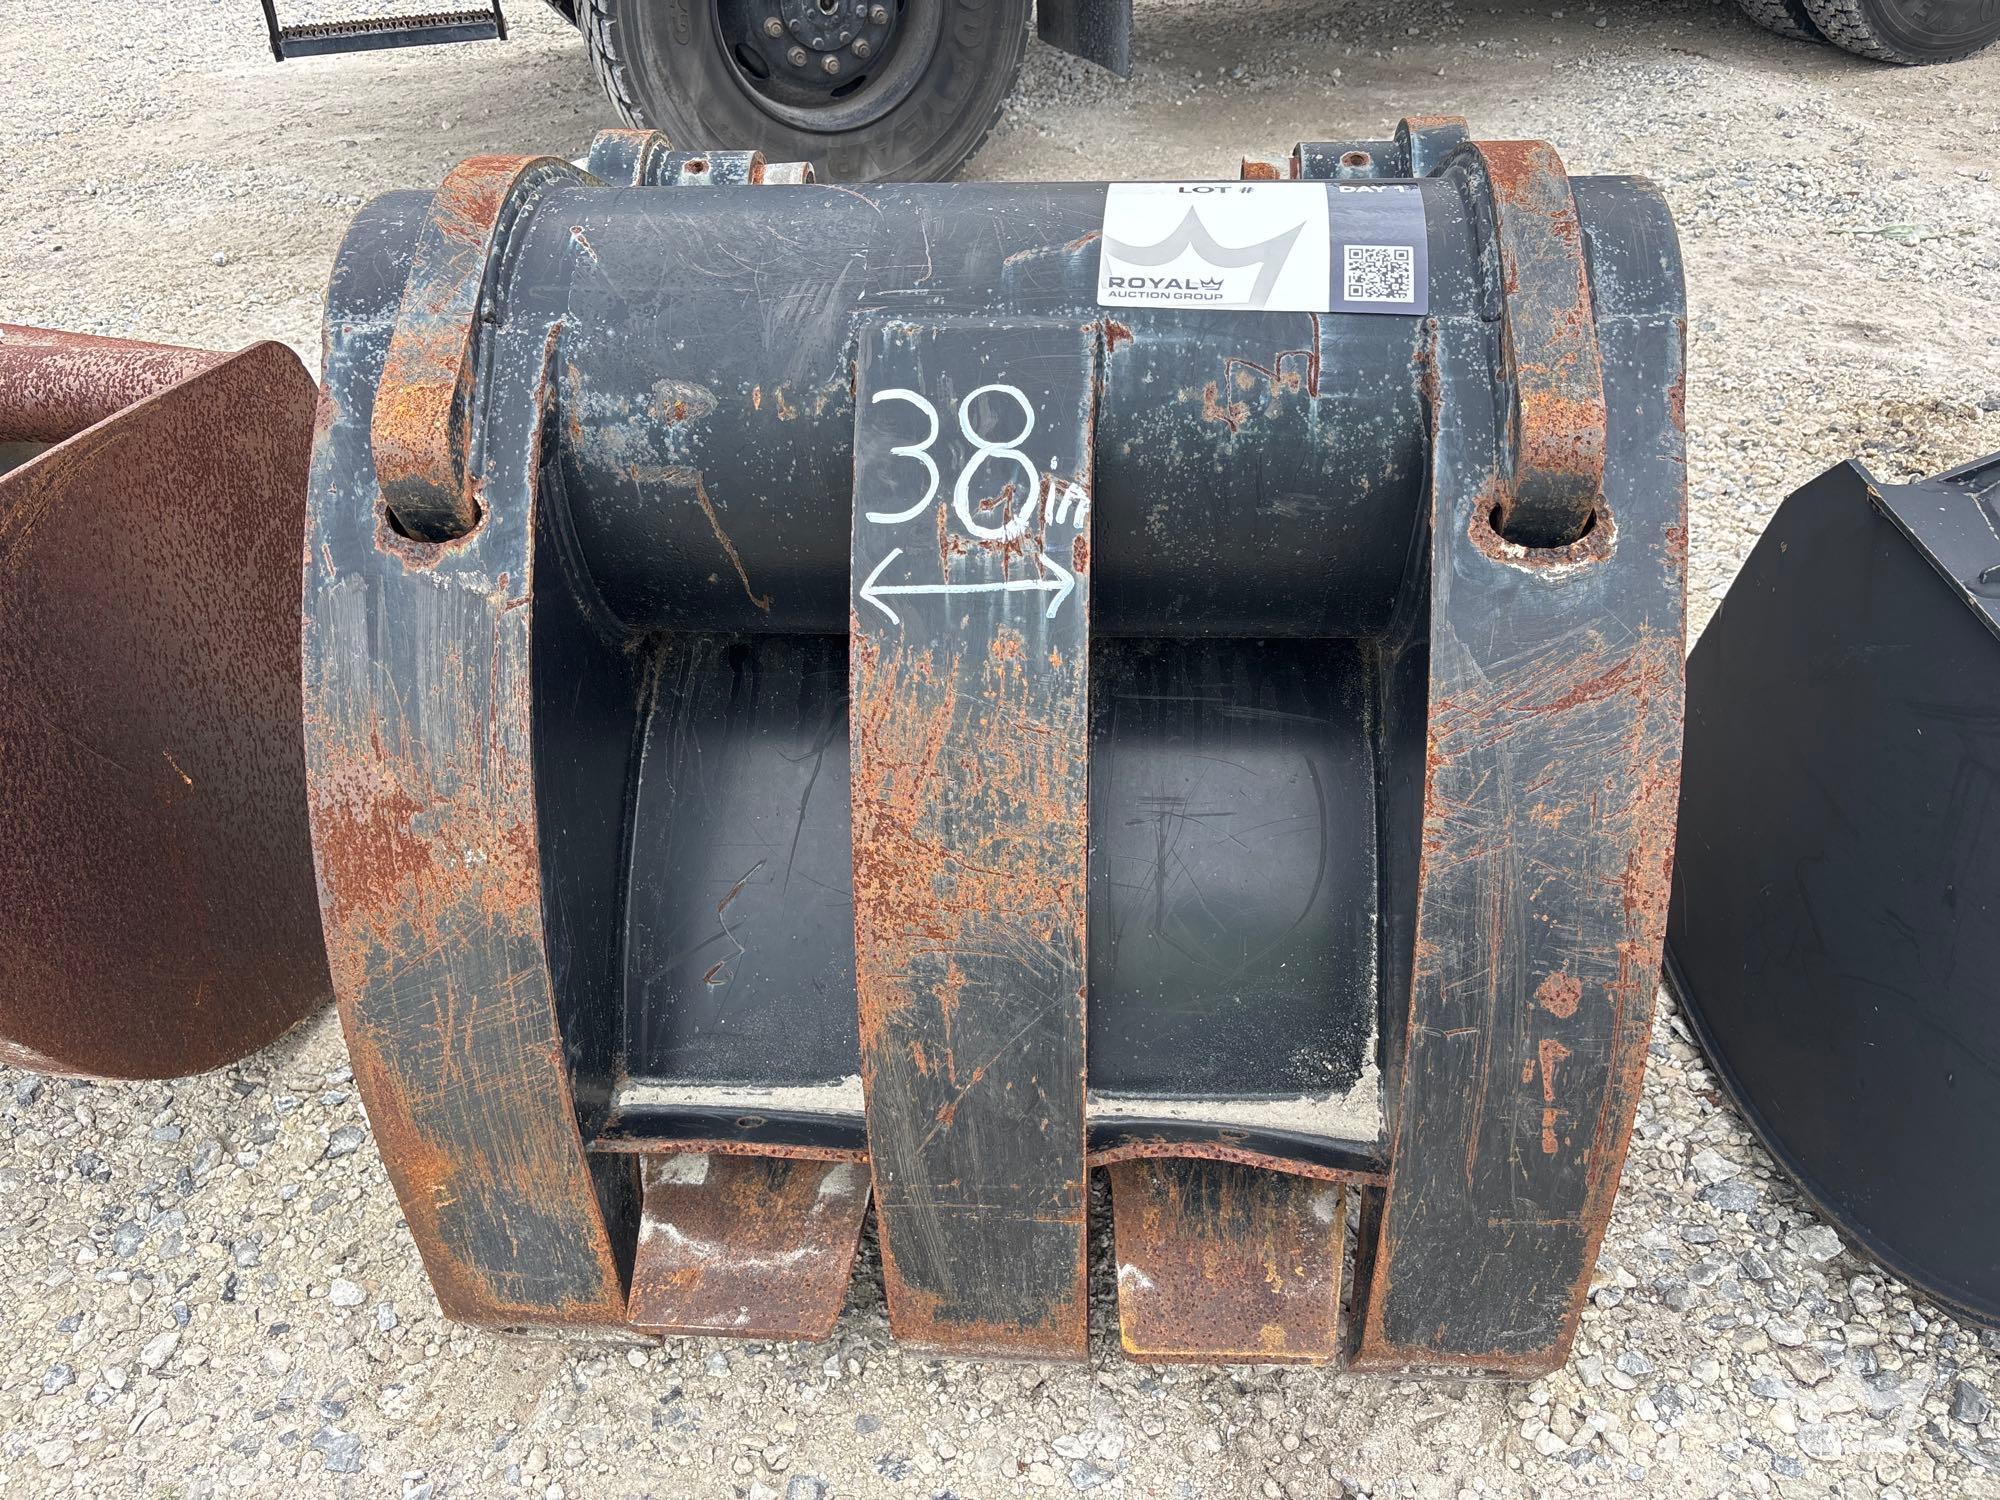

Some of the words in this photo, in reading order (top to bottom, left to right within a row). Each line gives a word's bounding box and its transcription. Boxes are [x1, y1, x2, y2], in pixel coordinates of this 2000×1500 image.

[1339, 185, 1387, 193] DAY
[1109, 277, 1198, 290] ROYAL
[1108, 291, 1170, 299] AUCTION
[1174, 292, 1223, 301] GROUP
[865, 384, 1041, 541] 38
[1044, 455, 1090, 528] in
